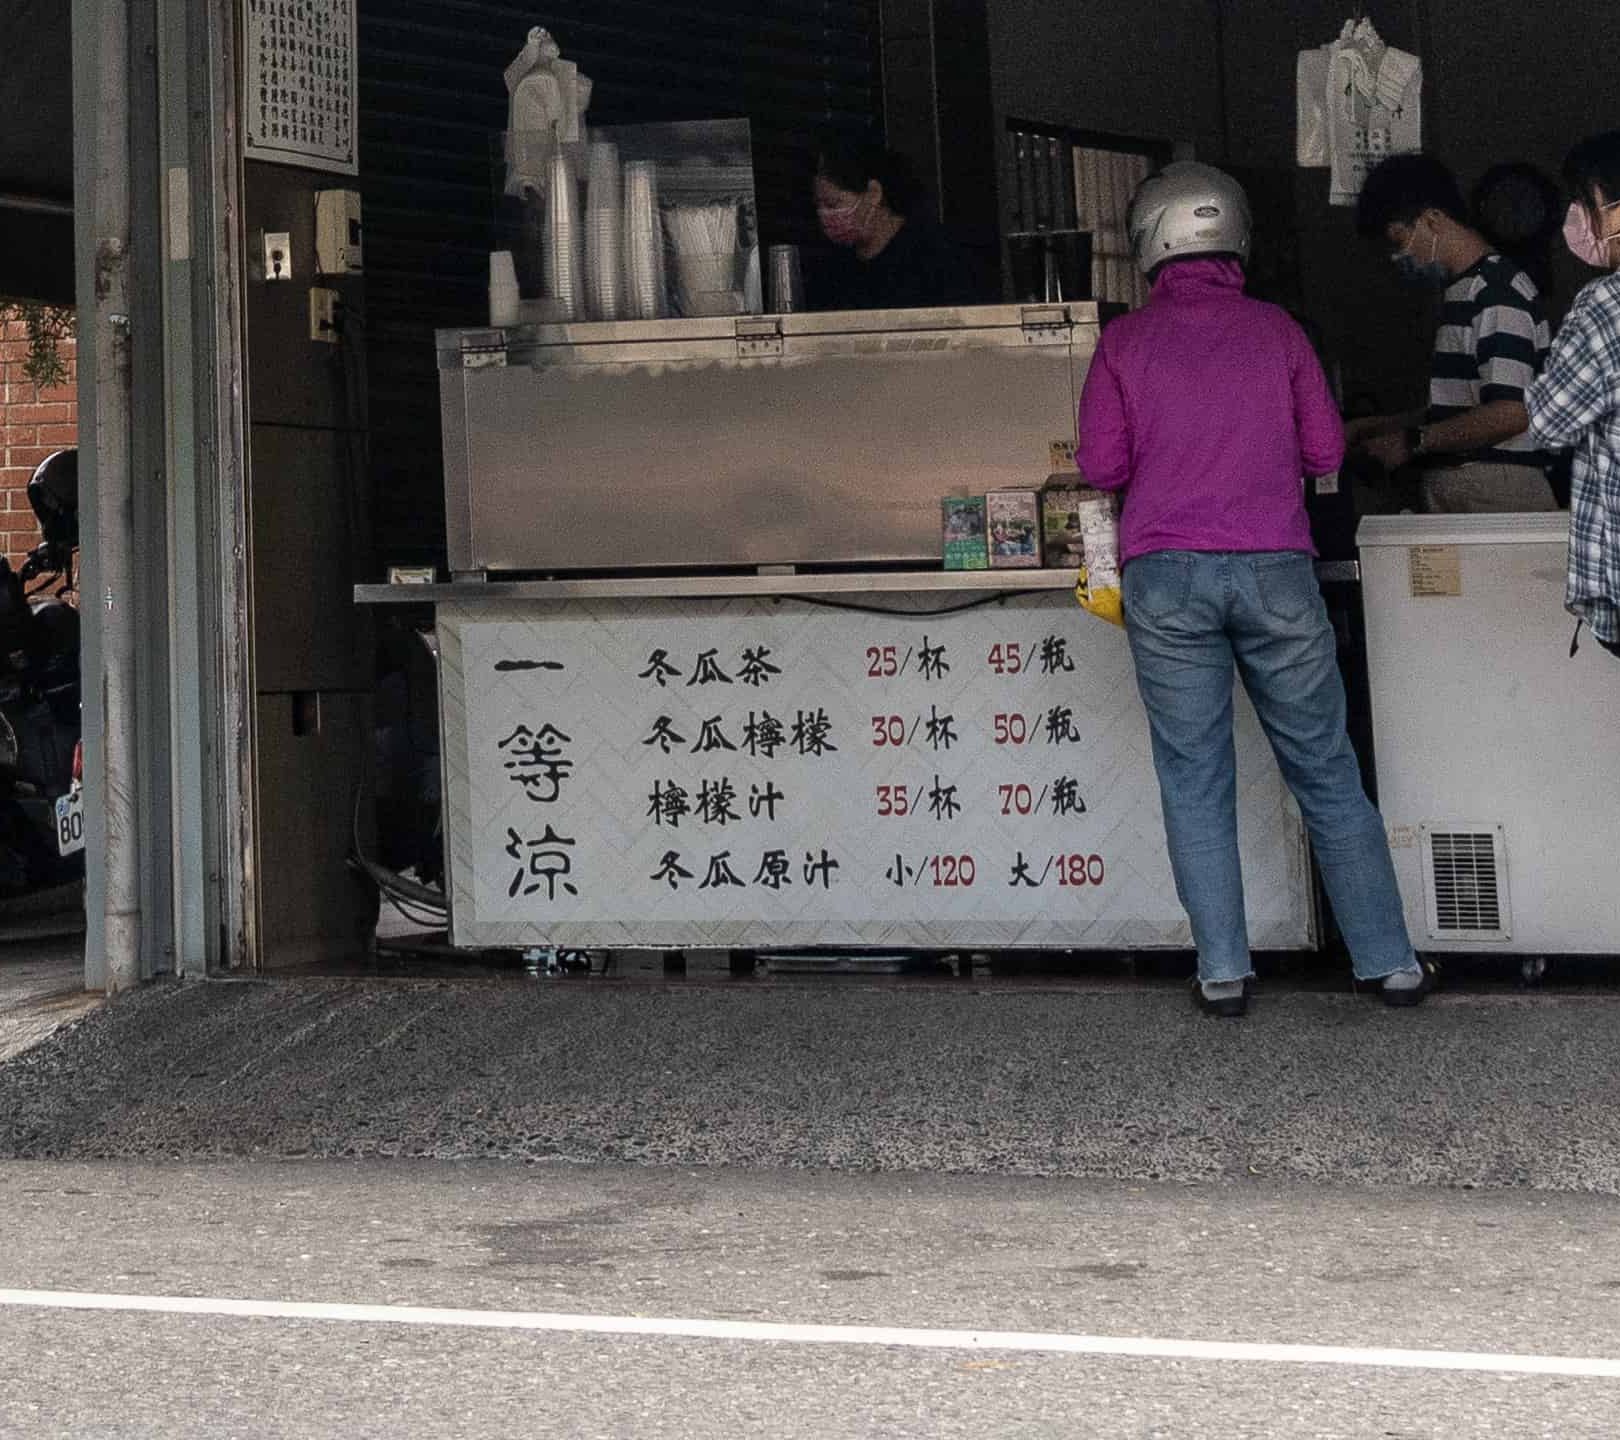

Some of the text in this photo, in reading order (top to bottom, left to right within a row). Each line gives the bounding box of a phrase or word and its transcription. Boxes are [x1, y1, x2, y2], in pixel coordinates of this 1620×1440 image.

[637, 633, 1076, 689] 冬瓜茶 25/杯 45/瓶
[640, 703, 1082, 759] 冬瓜檸檬 30/杯 50/瓶
[493, 658, 579, 902] 一等涼
[646, 773, 1088, 827] 檸檬汁 35/杯 70/瓶
[650, 849, 1107, 891] 冬瓜原汁 小/120 大/180
